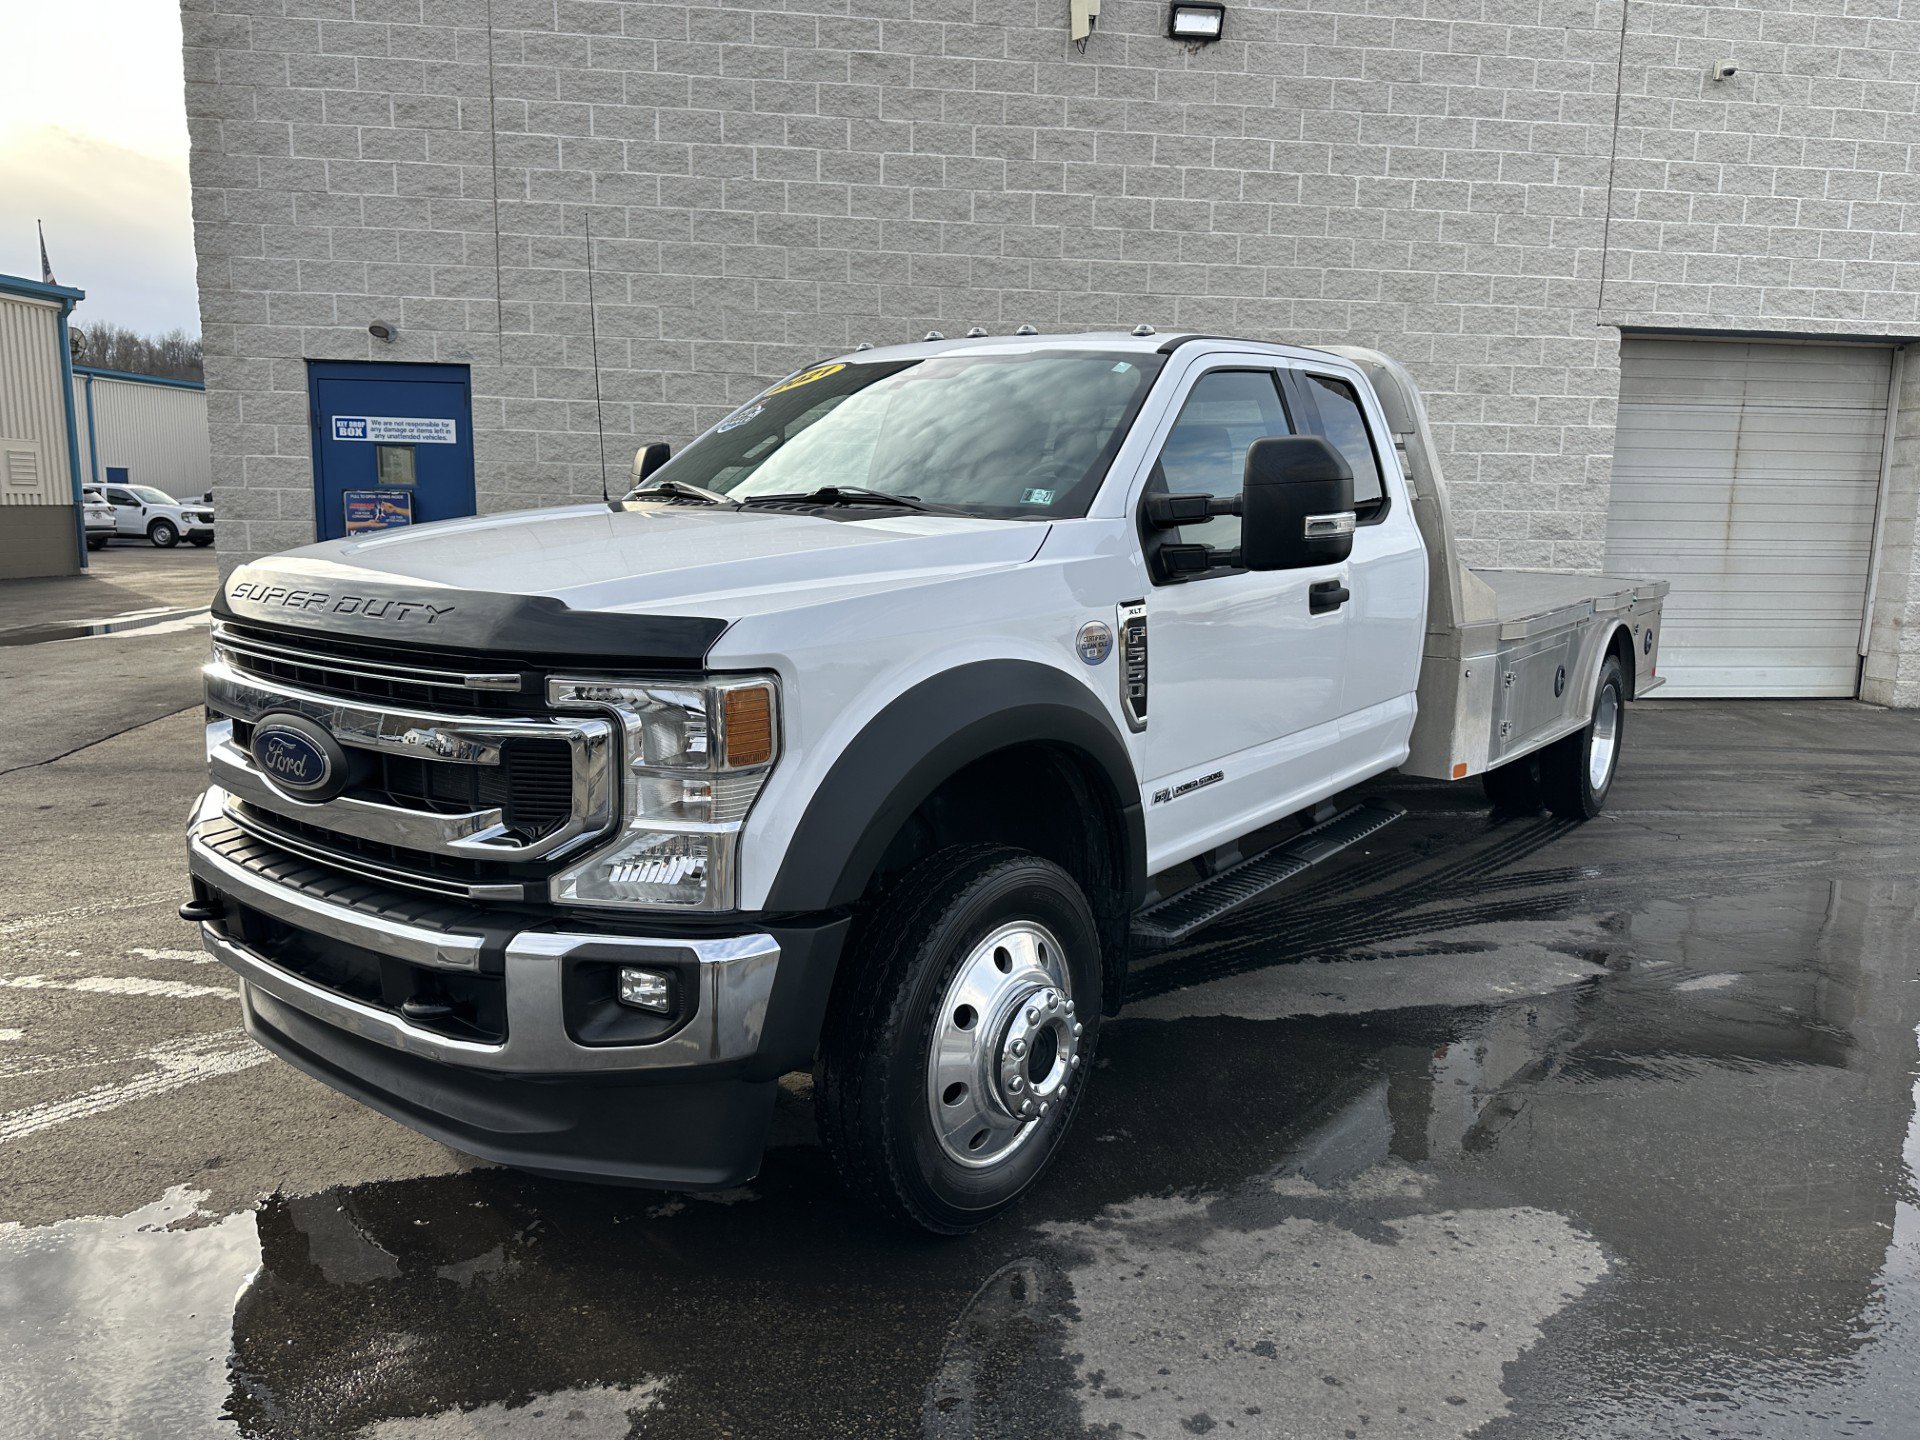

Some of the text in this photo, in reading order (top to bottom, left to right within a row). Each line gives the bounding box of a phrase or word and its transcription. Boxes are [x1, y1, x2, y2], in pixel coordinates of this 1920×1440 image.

[338, 427, 364, 437] BOX
[231, 582, 455, 625] SUPER DUTY
[1129, 607, 1142, 615] XLT
[1083, 634, 1106, 643] CERTIFIED
[265, 736, 308, 778] Ford
[1175, 780, 1198, 795] POWER
[1199, 771, 1225, 786] STROKE
